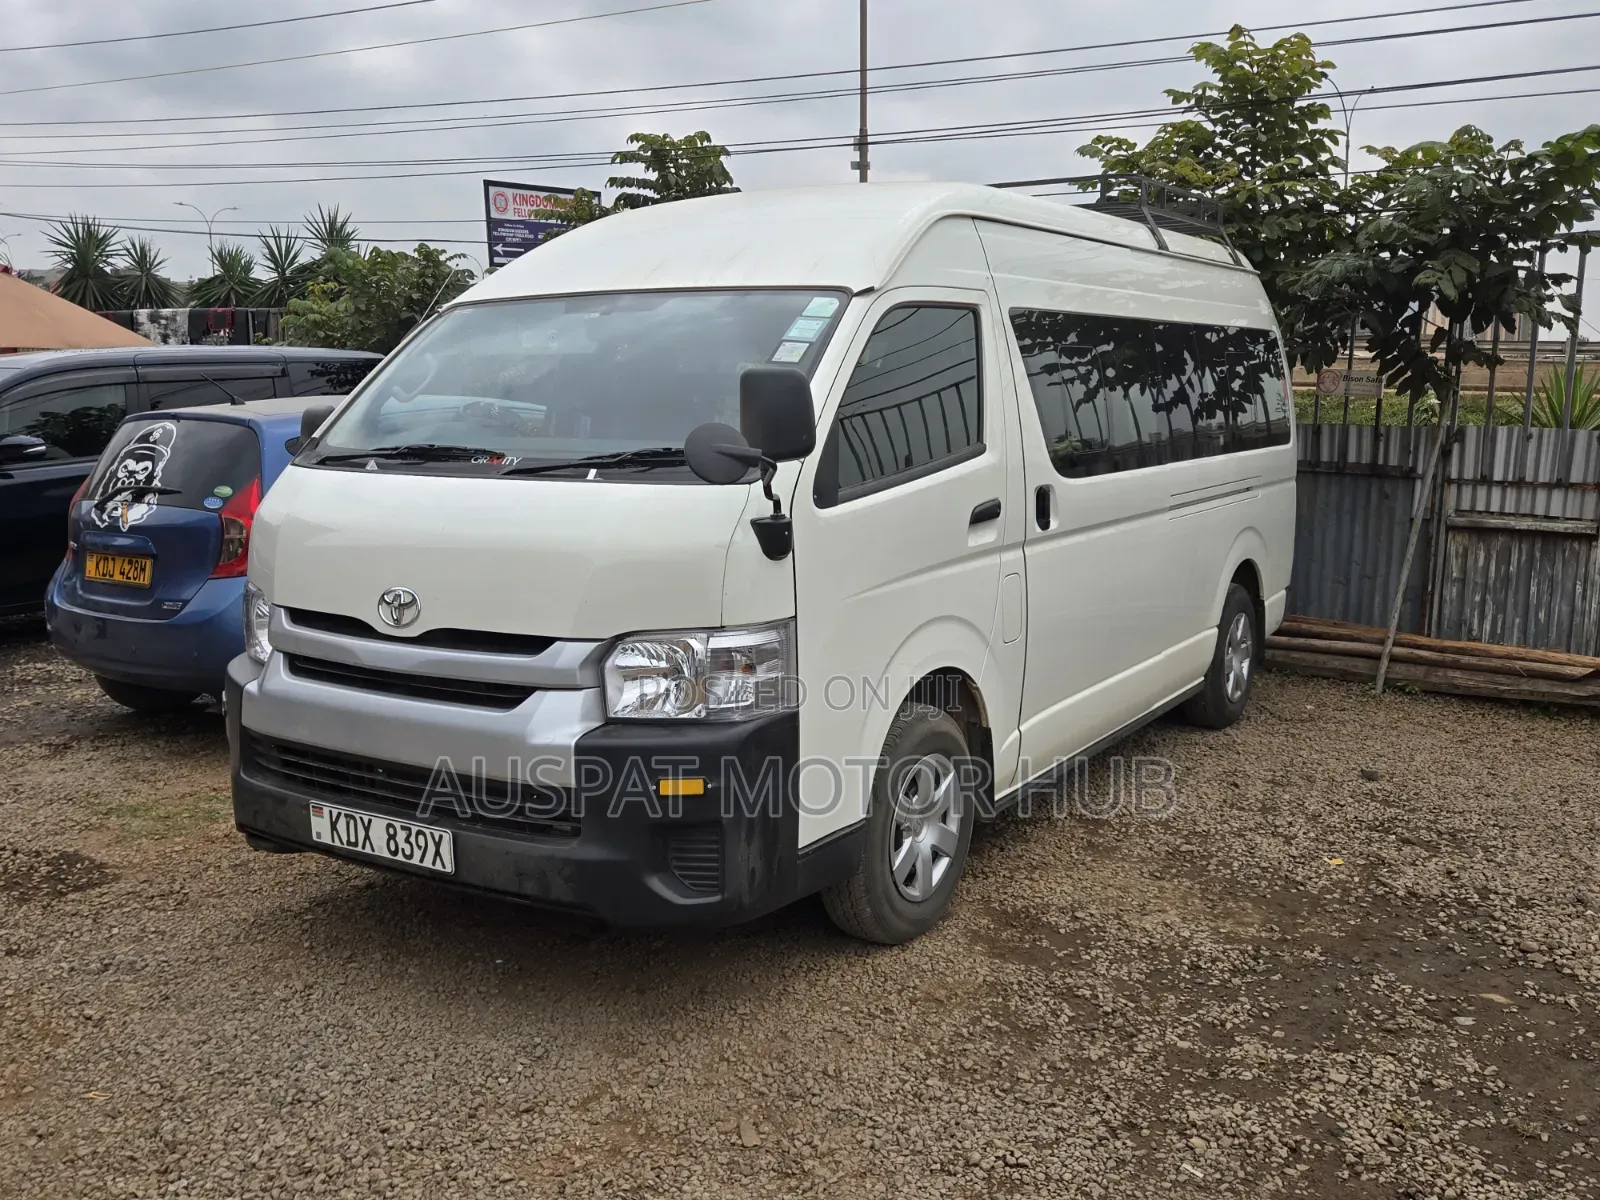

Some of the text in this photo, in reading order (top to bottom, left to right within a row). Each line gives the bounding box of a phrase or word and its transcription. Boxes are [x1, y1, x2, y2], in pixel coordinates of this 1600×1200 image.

[1342, 374, 1364, 383] Bison
[471, 455, 522, 466] GRAVITY
[94, 555, 147, 582] KDJ 428M
[328, 809, 447, 870] KDX 839X
